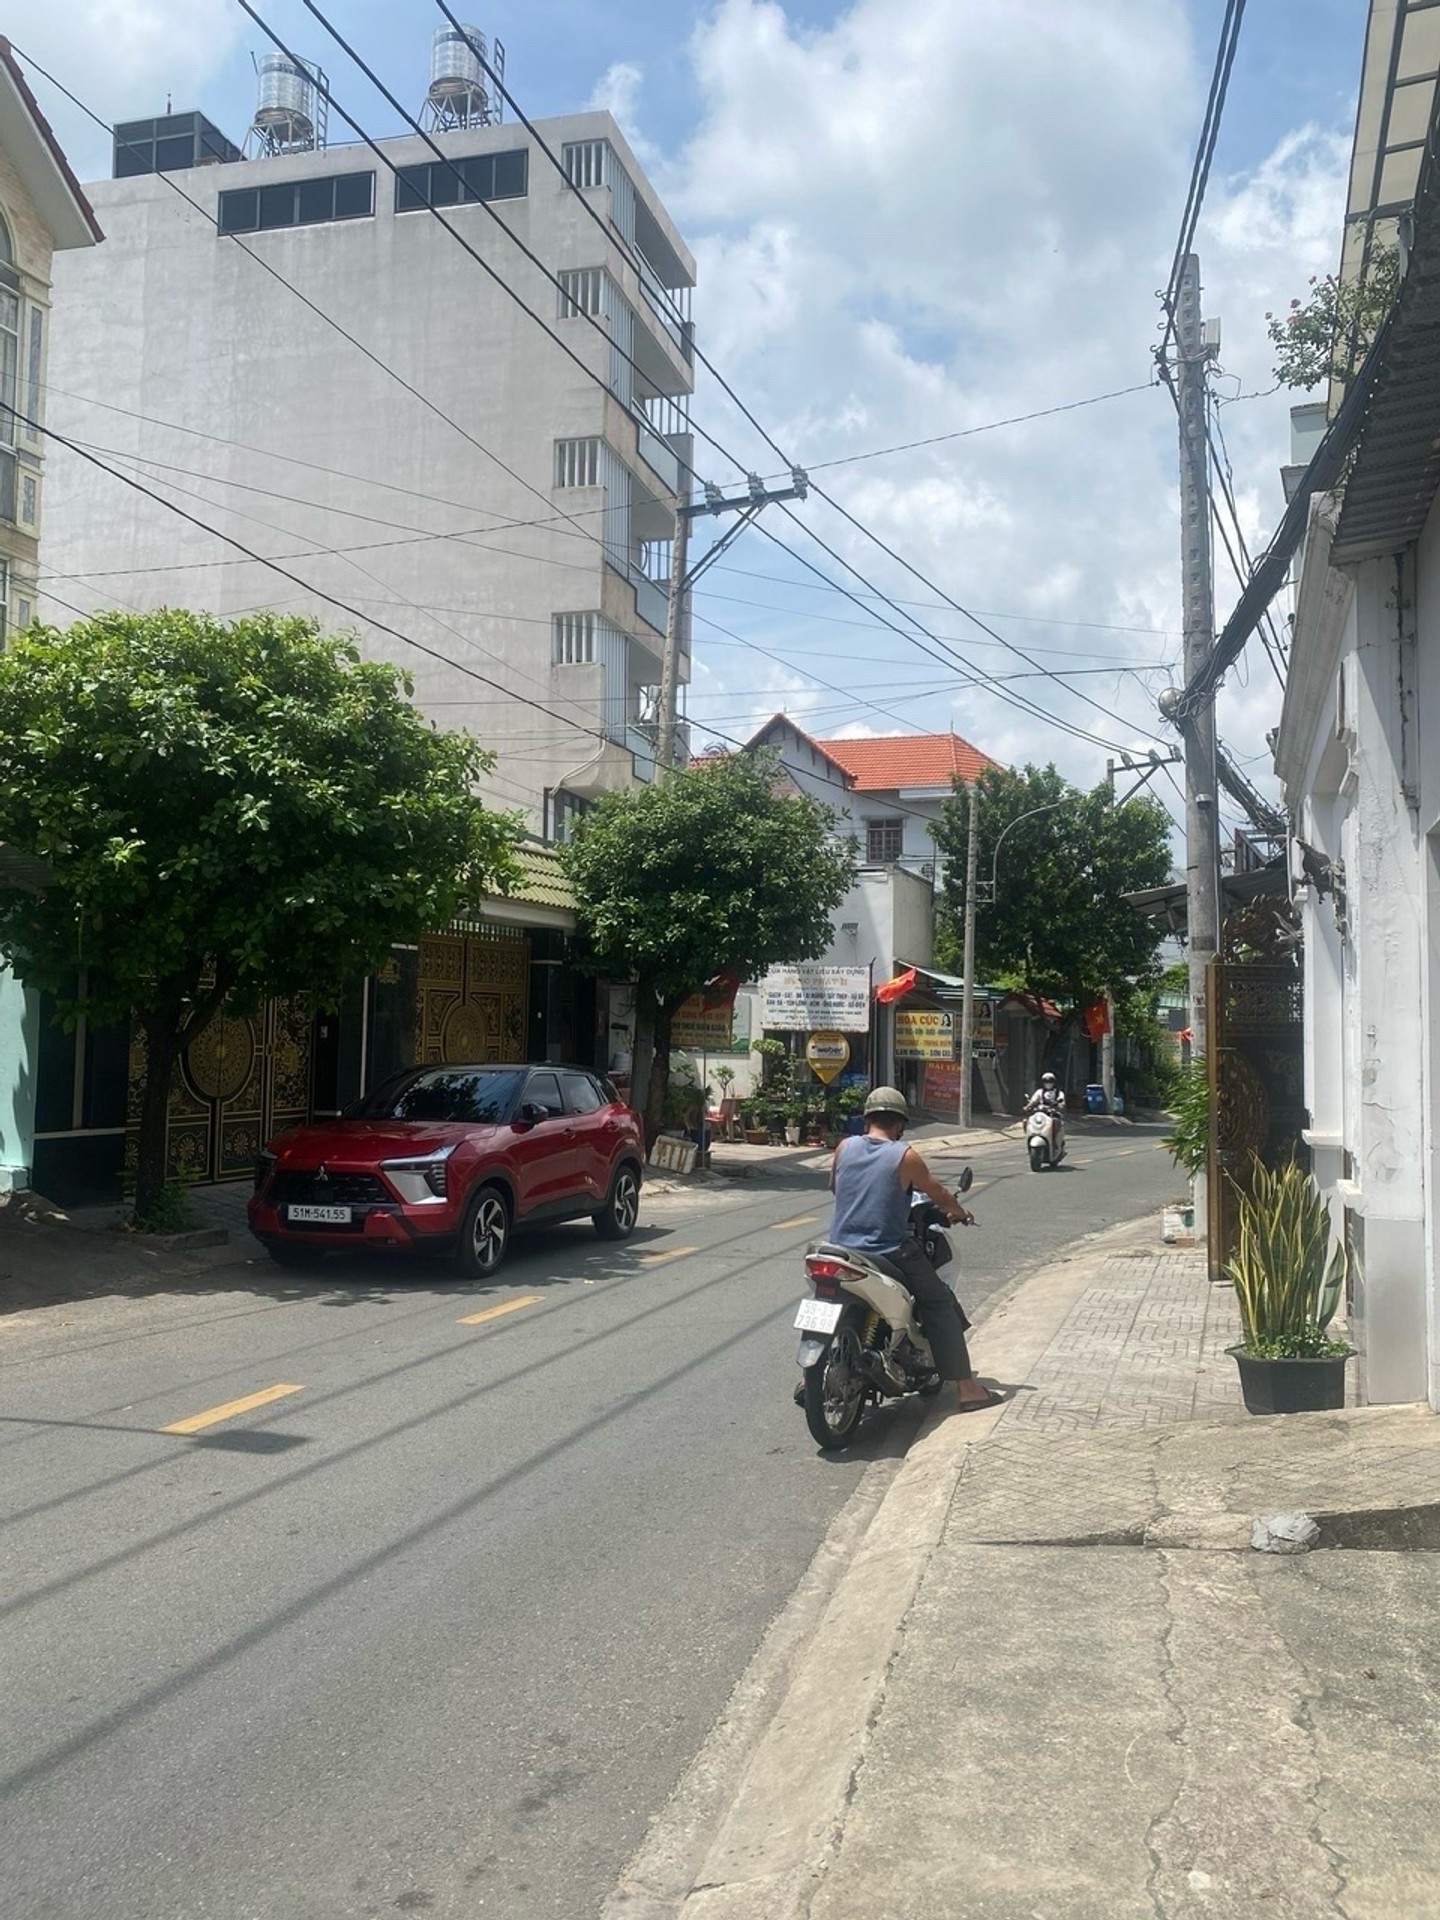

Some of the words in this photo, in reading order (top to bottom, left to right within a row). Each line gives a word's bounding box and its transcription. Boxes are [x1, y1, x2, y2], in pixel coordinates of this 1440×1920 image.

[831, 966, 845, 975] XÂY
[897, 1014, 917, 1025] HOA
[919, 1013, 939, 1026] CÚC
[293, 1207, 346, 1220] 51M-541.55
